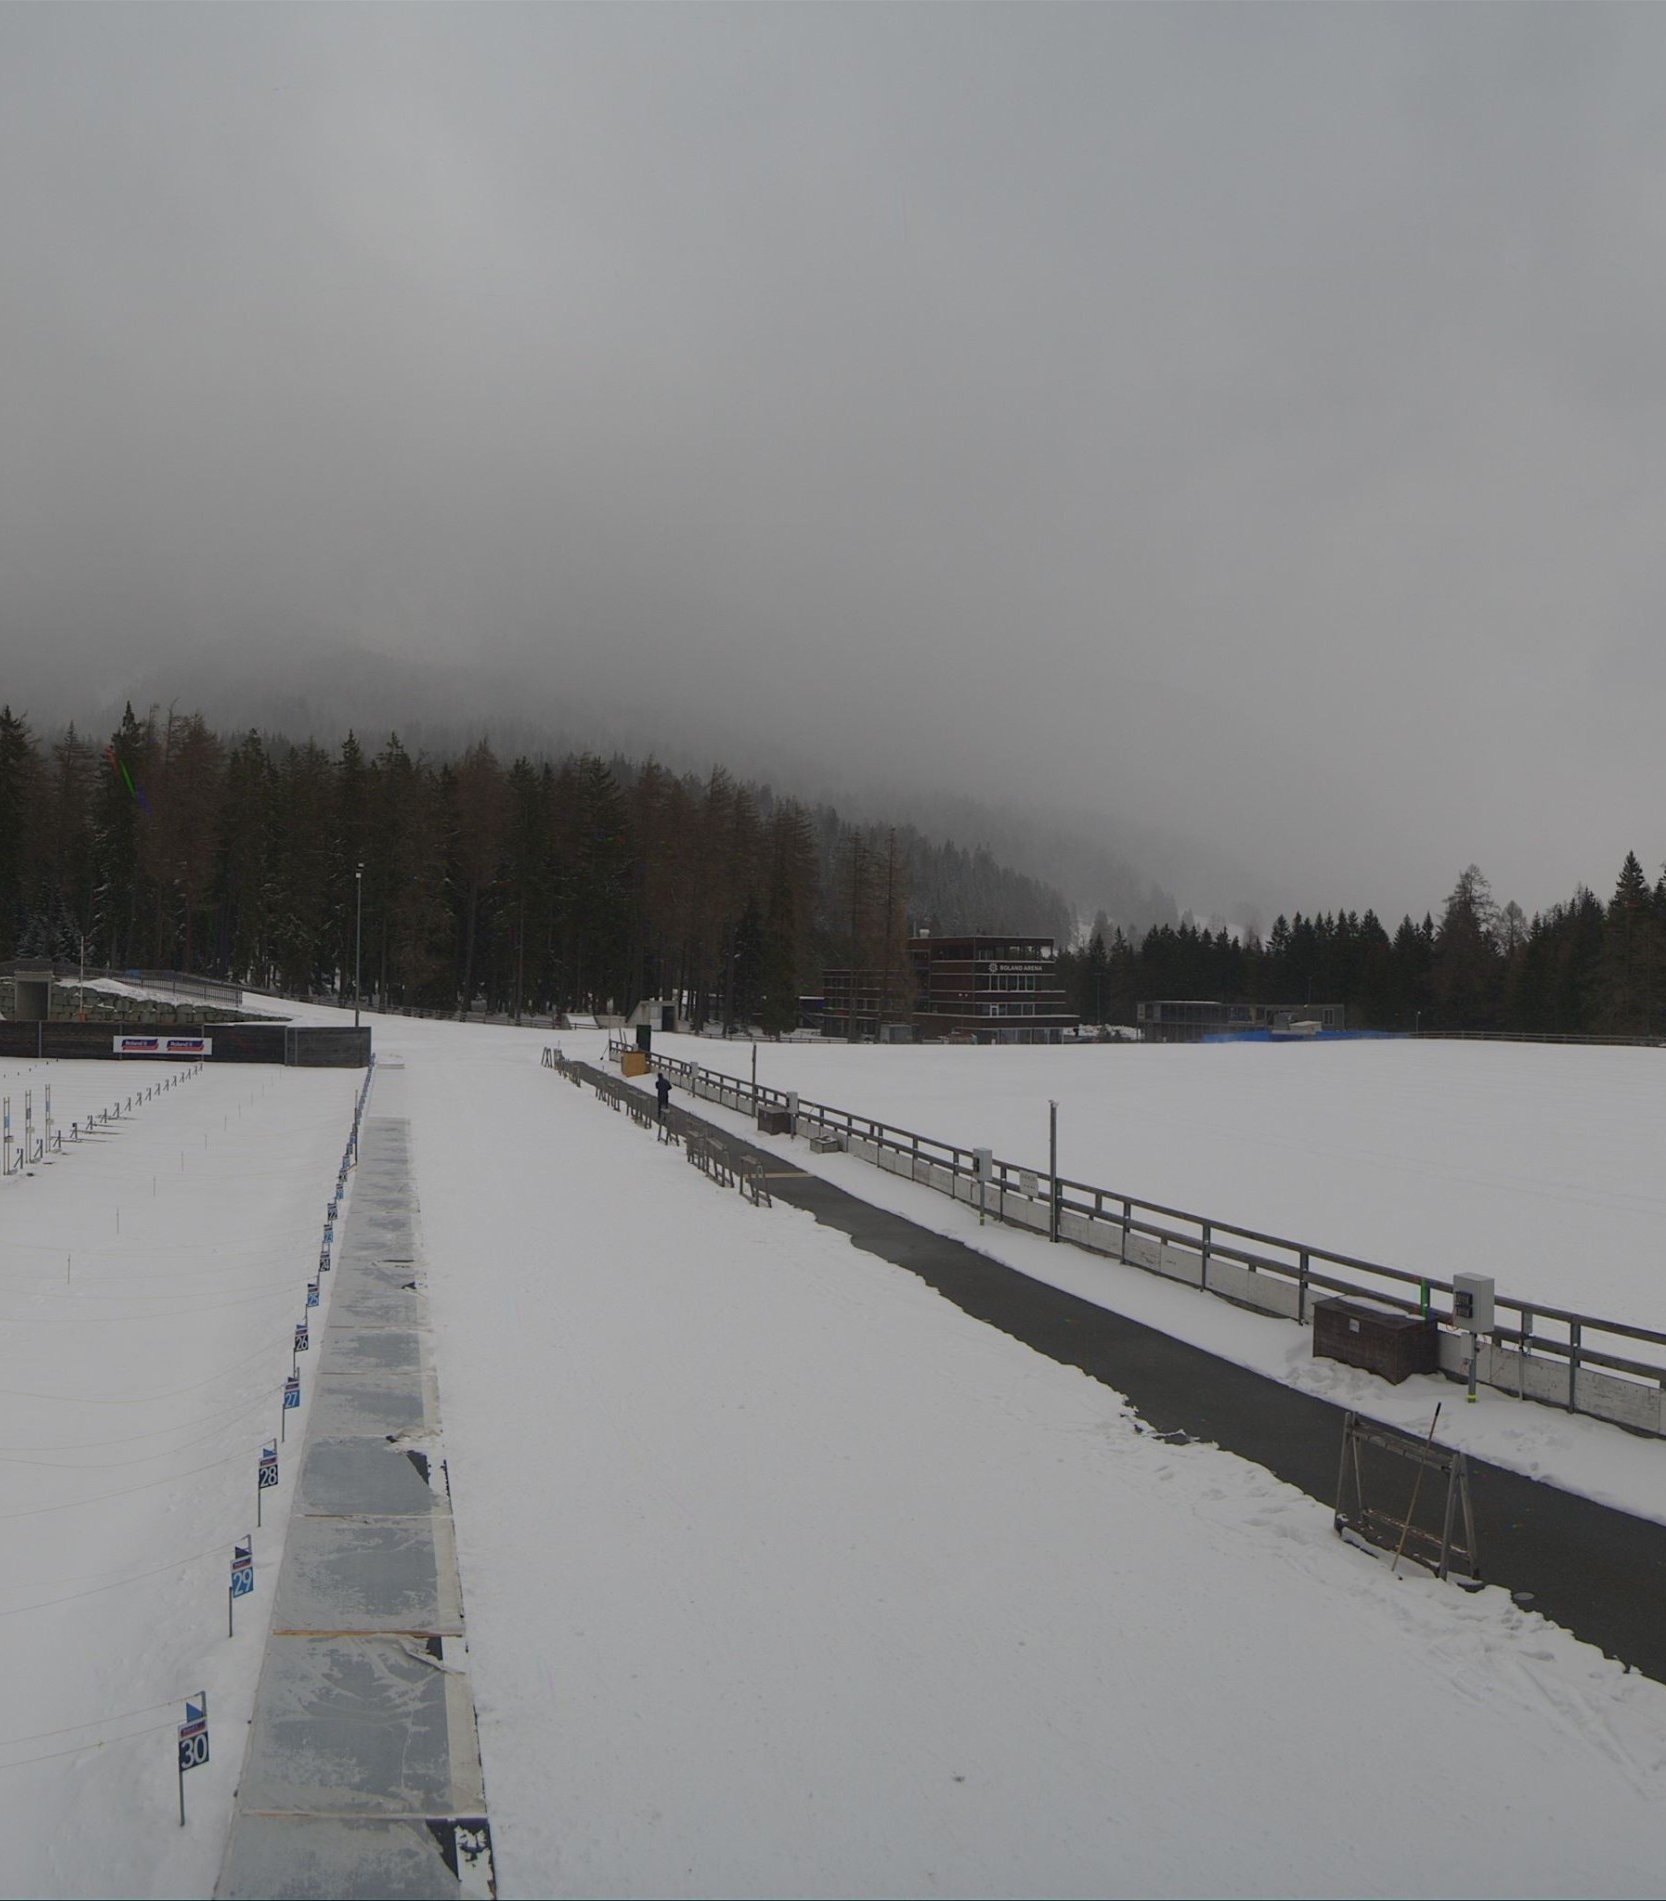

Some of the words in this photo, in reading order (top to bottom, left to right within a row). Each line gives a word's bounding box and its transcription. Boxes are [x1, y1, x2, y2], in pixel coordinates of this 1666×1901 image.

[296, 1335, 308, 1351] 26
[285, 1392, 298, 1408] 27
[260, 1466, 277, 1488] 28
[233, 1569, 252, 1596] 29
[181, 1734, 208, 1769] 30
